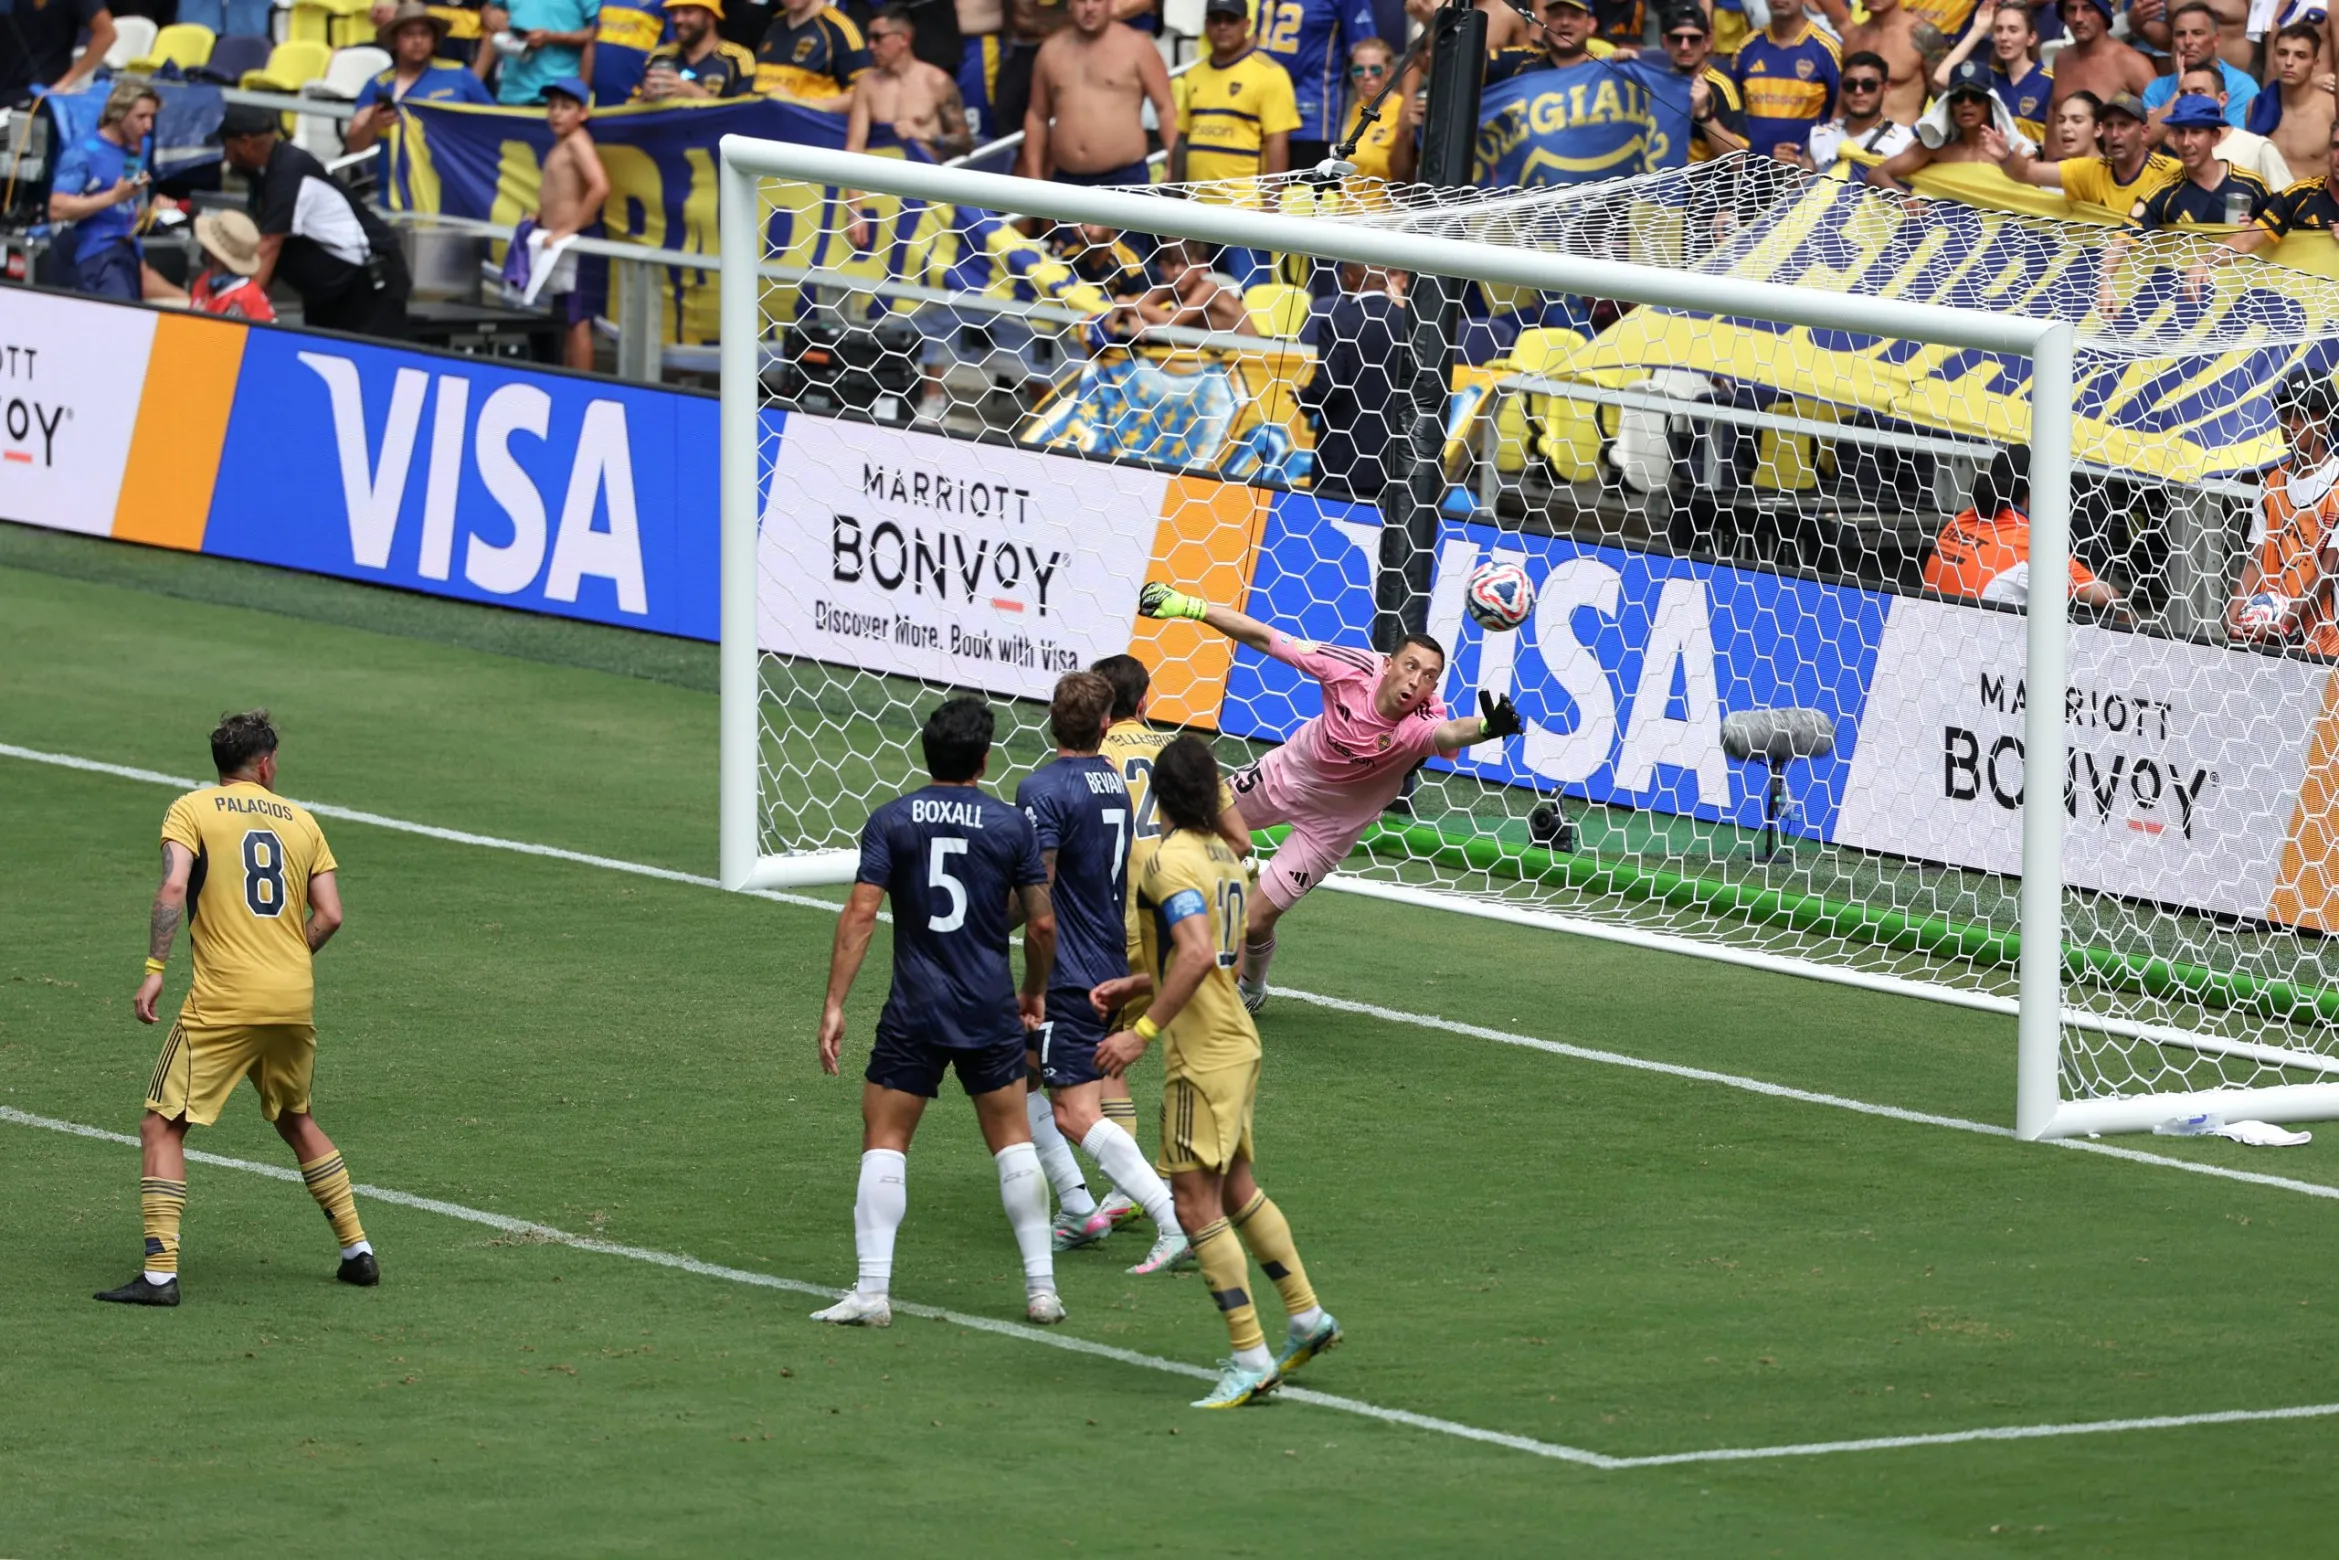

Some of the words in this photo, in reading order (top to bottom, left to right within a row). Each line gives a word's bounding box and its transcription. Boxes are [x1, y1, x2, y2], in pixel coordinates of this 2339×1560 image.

[1256, 0, 1304, 54] 12
[297, 350, 647, 614] VISA
[863, 462, 1031, 524] MARRIOTT
[832, 514, 1062, 616] BONVOY
[815, 600, 889, 641] Discover
[894, 613, 944, 650] More.
[950, 627, 995, 660] Book
[998, 638, 1036, 666] with
[1040, 640, 1080, 673] Visa
[1330, 519, 1731, 808] VISA
[1105, 732, 1178, 748] ELLEGRI
[1981, 672, 2172, 740] MARIOTT
[214, 795, 294, 822] PALACIOS
[911, 799, 984, 830] BOXALL
[1084, 771, 1126, 794] BEVAN
[240, 829, 287, 919] 8
[928, 836, 969, 933] 5
[1101, 808, 1127, 901] 7
[1215, 876, 1246, 969] 10
[1038, 1020, 1054, 1064] 7
